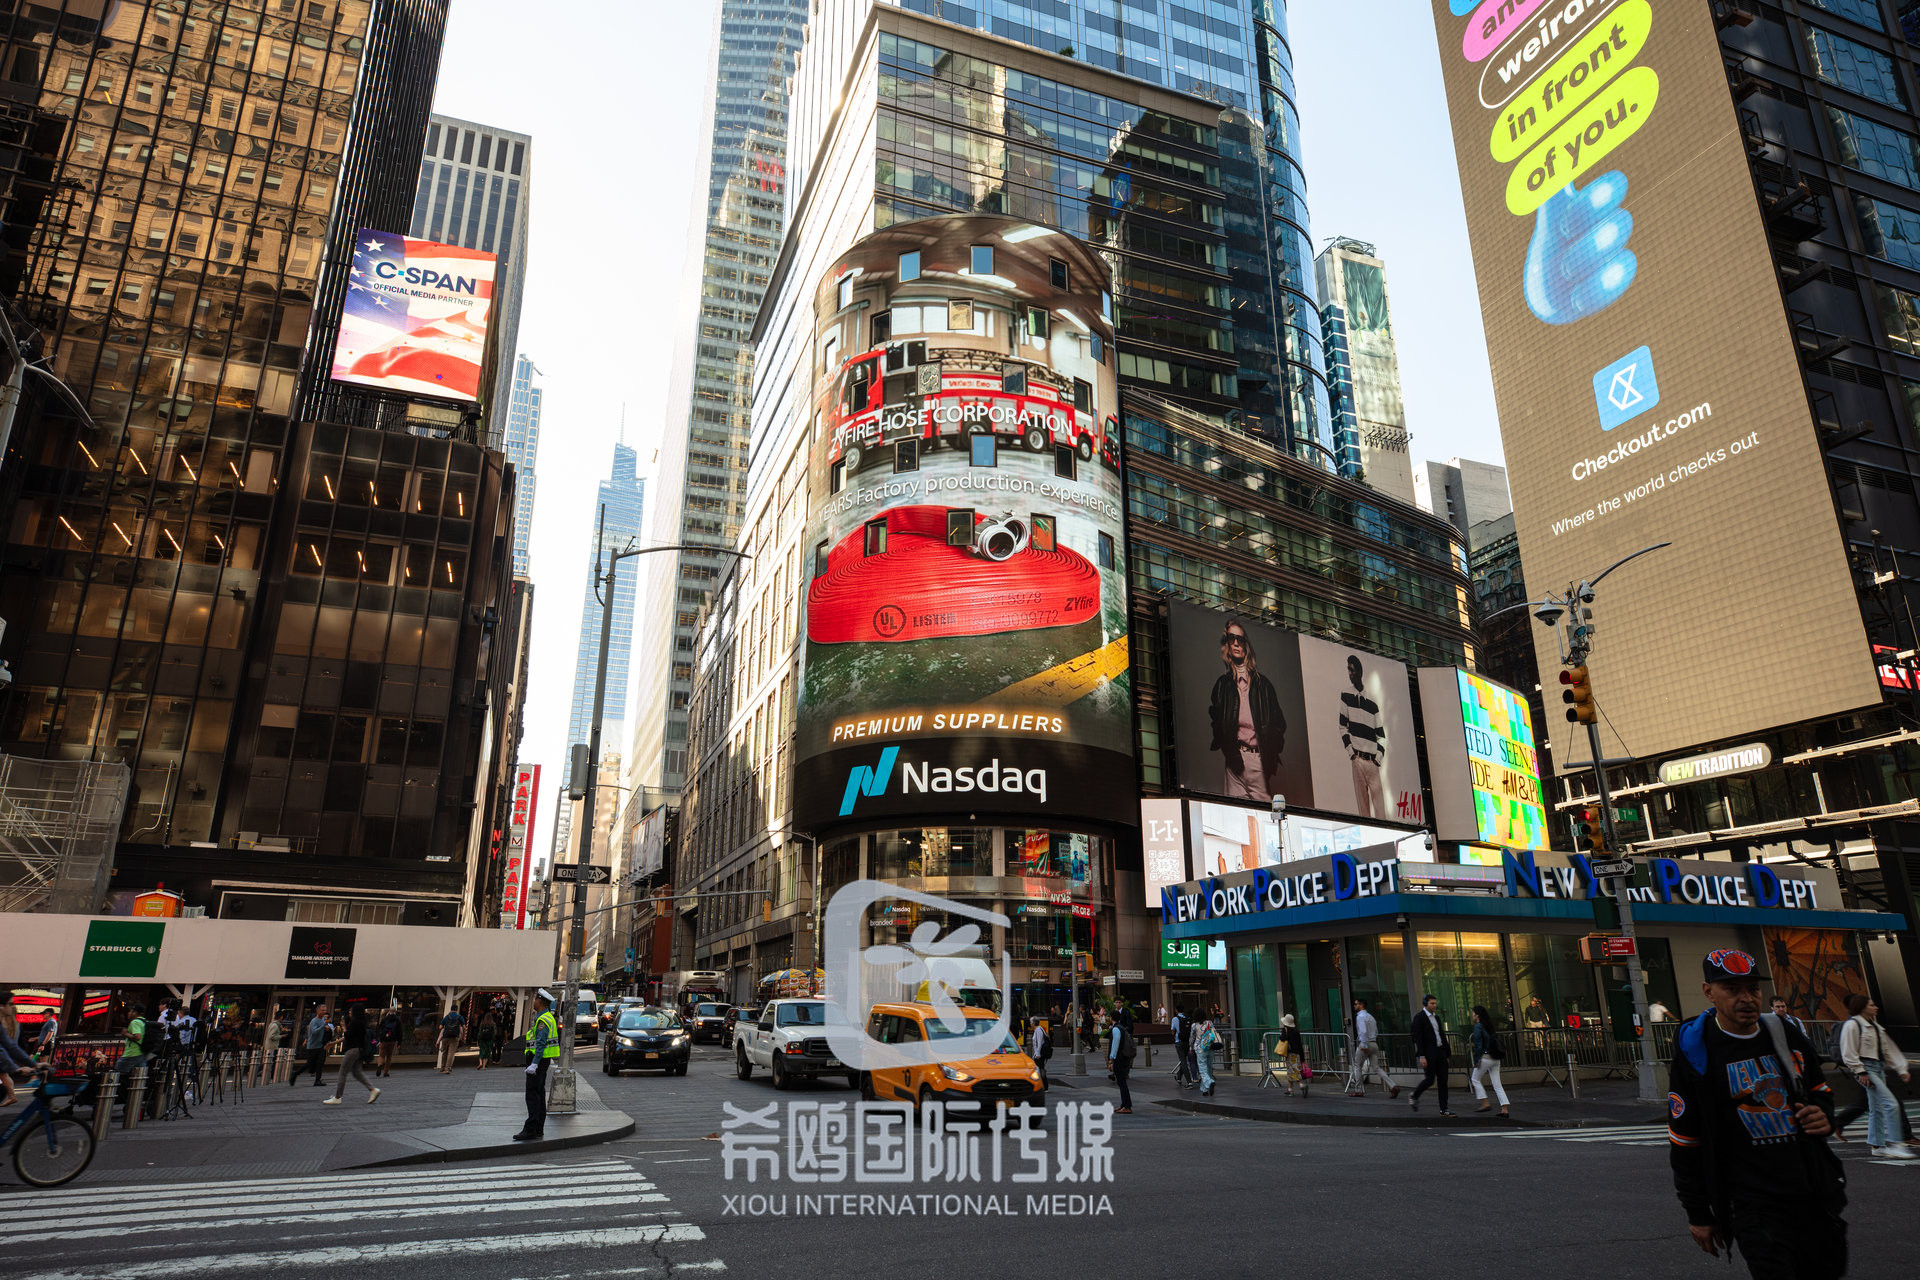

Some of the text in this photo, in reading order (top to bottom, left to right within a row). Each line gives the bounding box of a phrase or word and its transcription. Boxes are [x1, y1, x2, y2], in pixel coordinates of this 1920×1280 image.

[1507, 22, 1628, 142] in front
[1526, 97, 1639, 192] of you.
[373, 282, 474, 307] OFFICIAL MEDIA PARTNER
[375, 261, 477, 296] C-SPAN
[830, 405, 1074, 457] ZYFIRE HOSE CORPORATION
[1571, 401, 1713, 481] Checkout.com
[818, 472, 1118, 524] YEARS Factory production experience
[1551, 430, 1760, 536] Where the world checks out
[913, 612, 956, 628] LISTED
[832, 712, 1064, 743] PREMIUM SUPPLIERS
[512, 771, 531, 826] PARK
[902, 758, 1047, 804] Nasdaq
[1397, 790, 1422, 823] H&M
[503, 857, 522, 913] PARK
[1160, 852, 1401, 925] NEW YORK POLICE DEPT
[1502, 848, 1576, 899] NEW
[1654, 857, 1750, 907] POLICE
[1749, 862, 1818, 910] DEPT
[1595, 862, 1629, 874] ONE WAY
[1026, 906, 1047, 914] Nasdaq
[89, 945, 142, 953] STARBUCKS
[1726, 1058, 1759, 1099] NEW
[1737, 1109, 1798, 1139] KNIC
